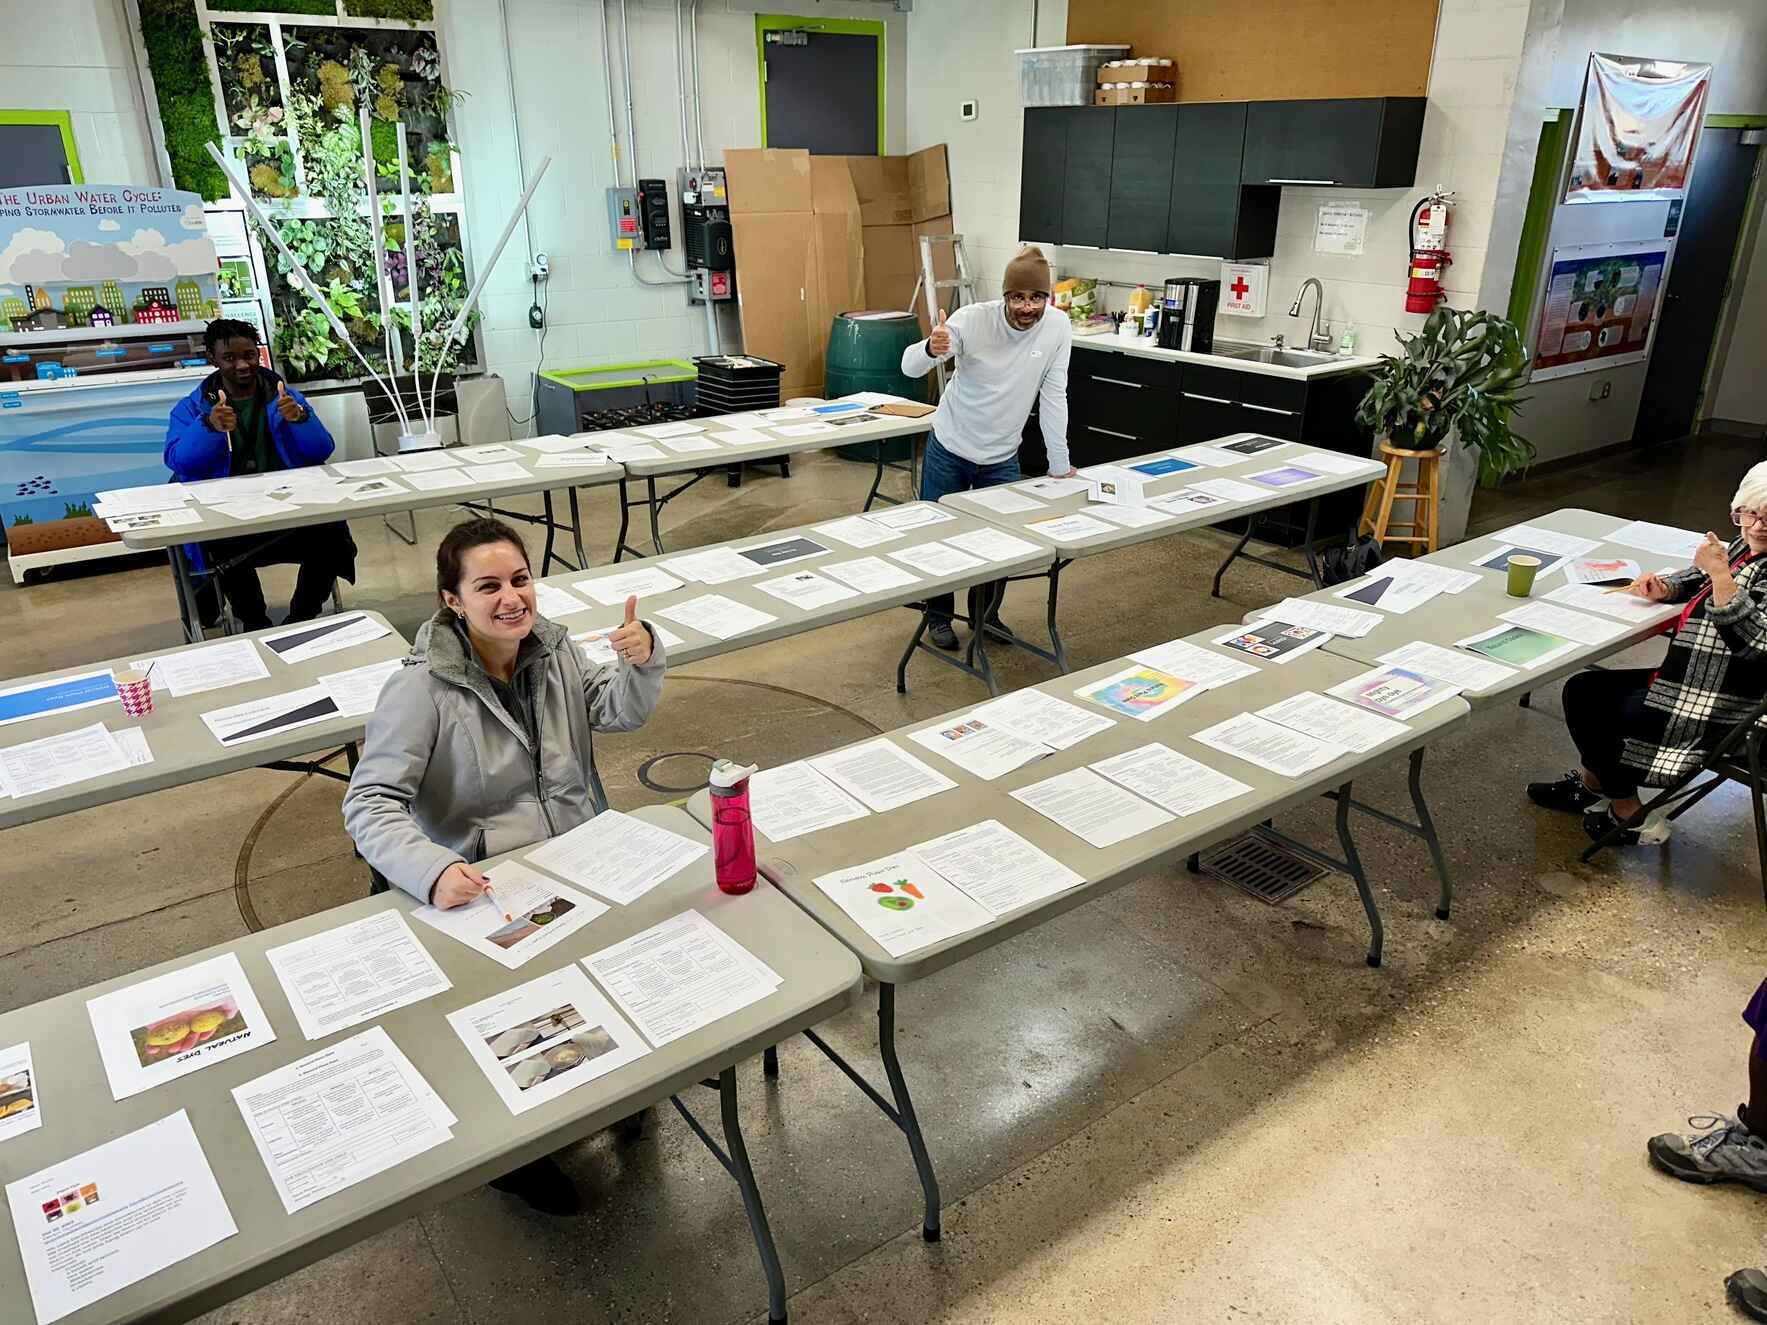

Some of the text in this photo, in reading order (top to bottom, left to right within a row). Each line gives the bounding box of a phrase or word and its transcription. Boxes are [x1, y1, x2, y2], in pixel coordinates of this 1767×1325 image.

[26, 191, 70, 206] URBAN
[74, 190, 118, 204] WATER
[122, 188, 162, 203] CYCLE:
[24, 205, 85, 217] STORMWATER
[89, 203, 124, 215] BEFORE
[1242, 303, 1251, 311] AID
[176, 1031, 251, 1063] NATURAL DYES
